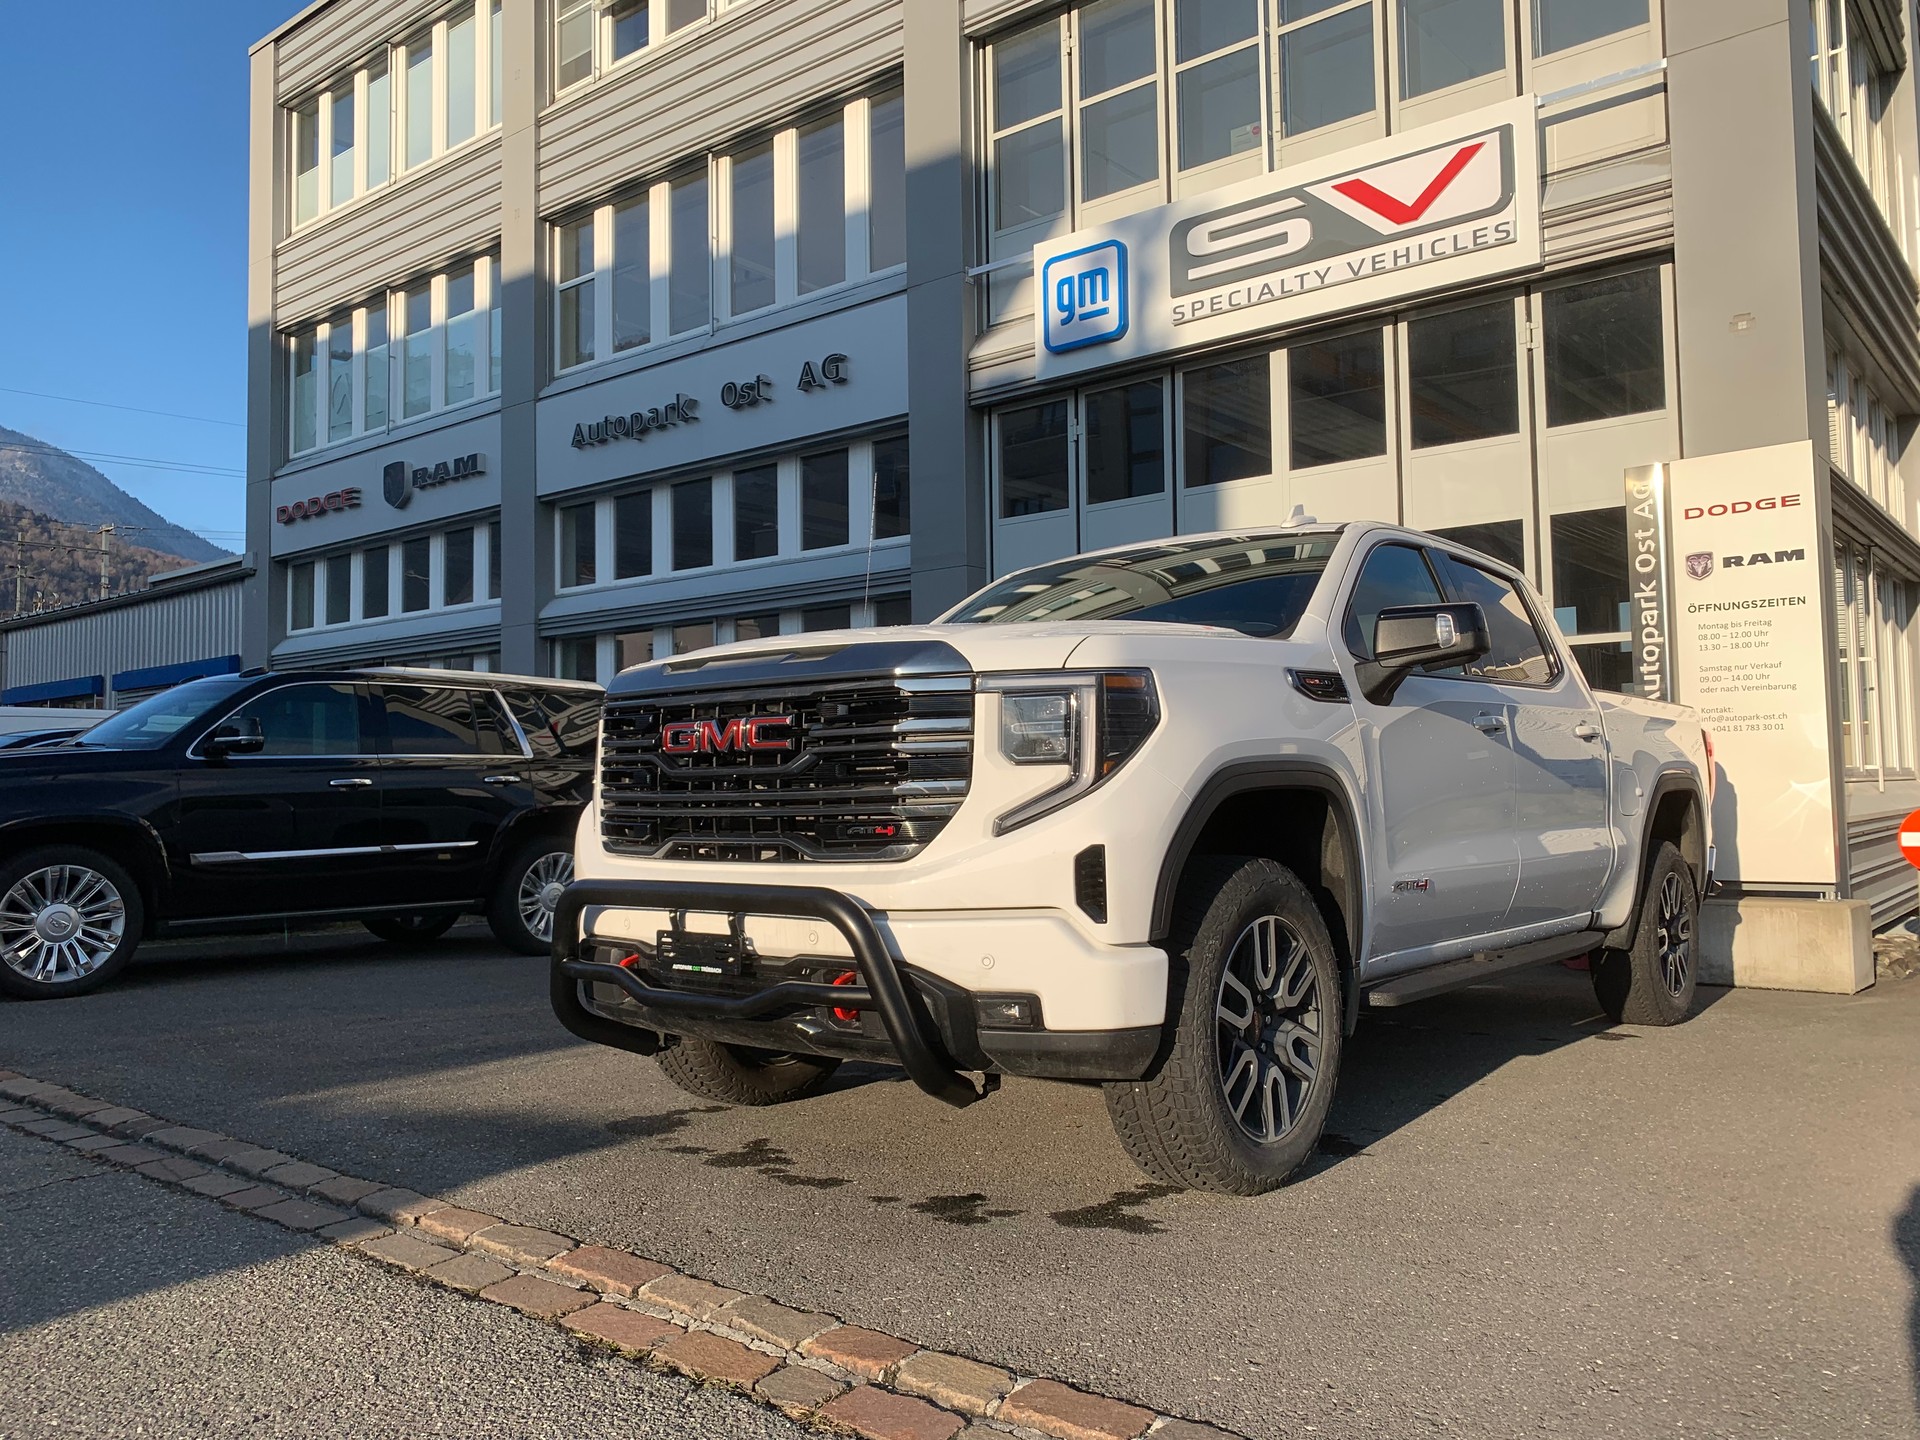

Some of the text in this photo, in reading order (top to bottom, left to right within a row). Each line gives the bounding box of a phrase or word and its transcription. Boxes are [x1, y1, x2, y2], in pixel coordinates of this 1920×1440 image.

[1187, 141, 1487, 281] SV
[1172, 221, 1511, 322] SPECIALTY VEHICLES
[1056, 266, 1110, 326] gm
[571, 353, 848, 449] Autopark Ost AG
[412, 453, 486, 488] RAM
[276, 487, 361, 524] DODGE
[1632, 482, 1654, 520] AG
[1684, 494, 1801, 520] DODGE
[1634, 527, 1656, 573] Ost
[1722, 548, 1805, 568] RAM
[1687, 596, 1806, 613] ÖFFNUNGSZEITEN
[1744, 619, 1772, 627] Freitag
[1698, 633, 1721, 641] 08.00
[1730, 631, 1752, 639] 12.00
[1699, 643, 1721, 651] 13.30
[1730, 641, 1752, 649] 18.00
[1754, 640, 1769, 648] Uhr
[1699, 665, 1732, 673] Samstag
[1750, 661, 1782, 670] Verkauf
[1699, 675, 1722, 683] 09.00
[1731, 673, 1753, 682] 14.00
[1741, 683, 1797, 692] Vereinbarung
[1701, 712, 1788, 723] info@autopark-ost.ch
[1763, 723, 1773, 731] 30
[662, 714, 796, 753] GMC
